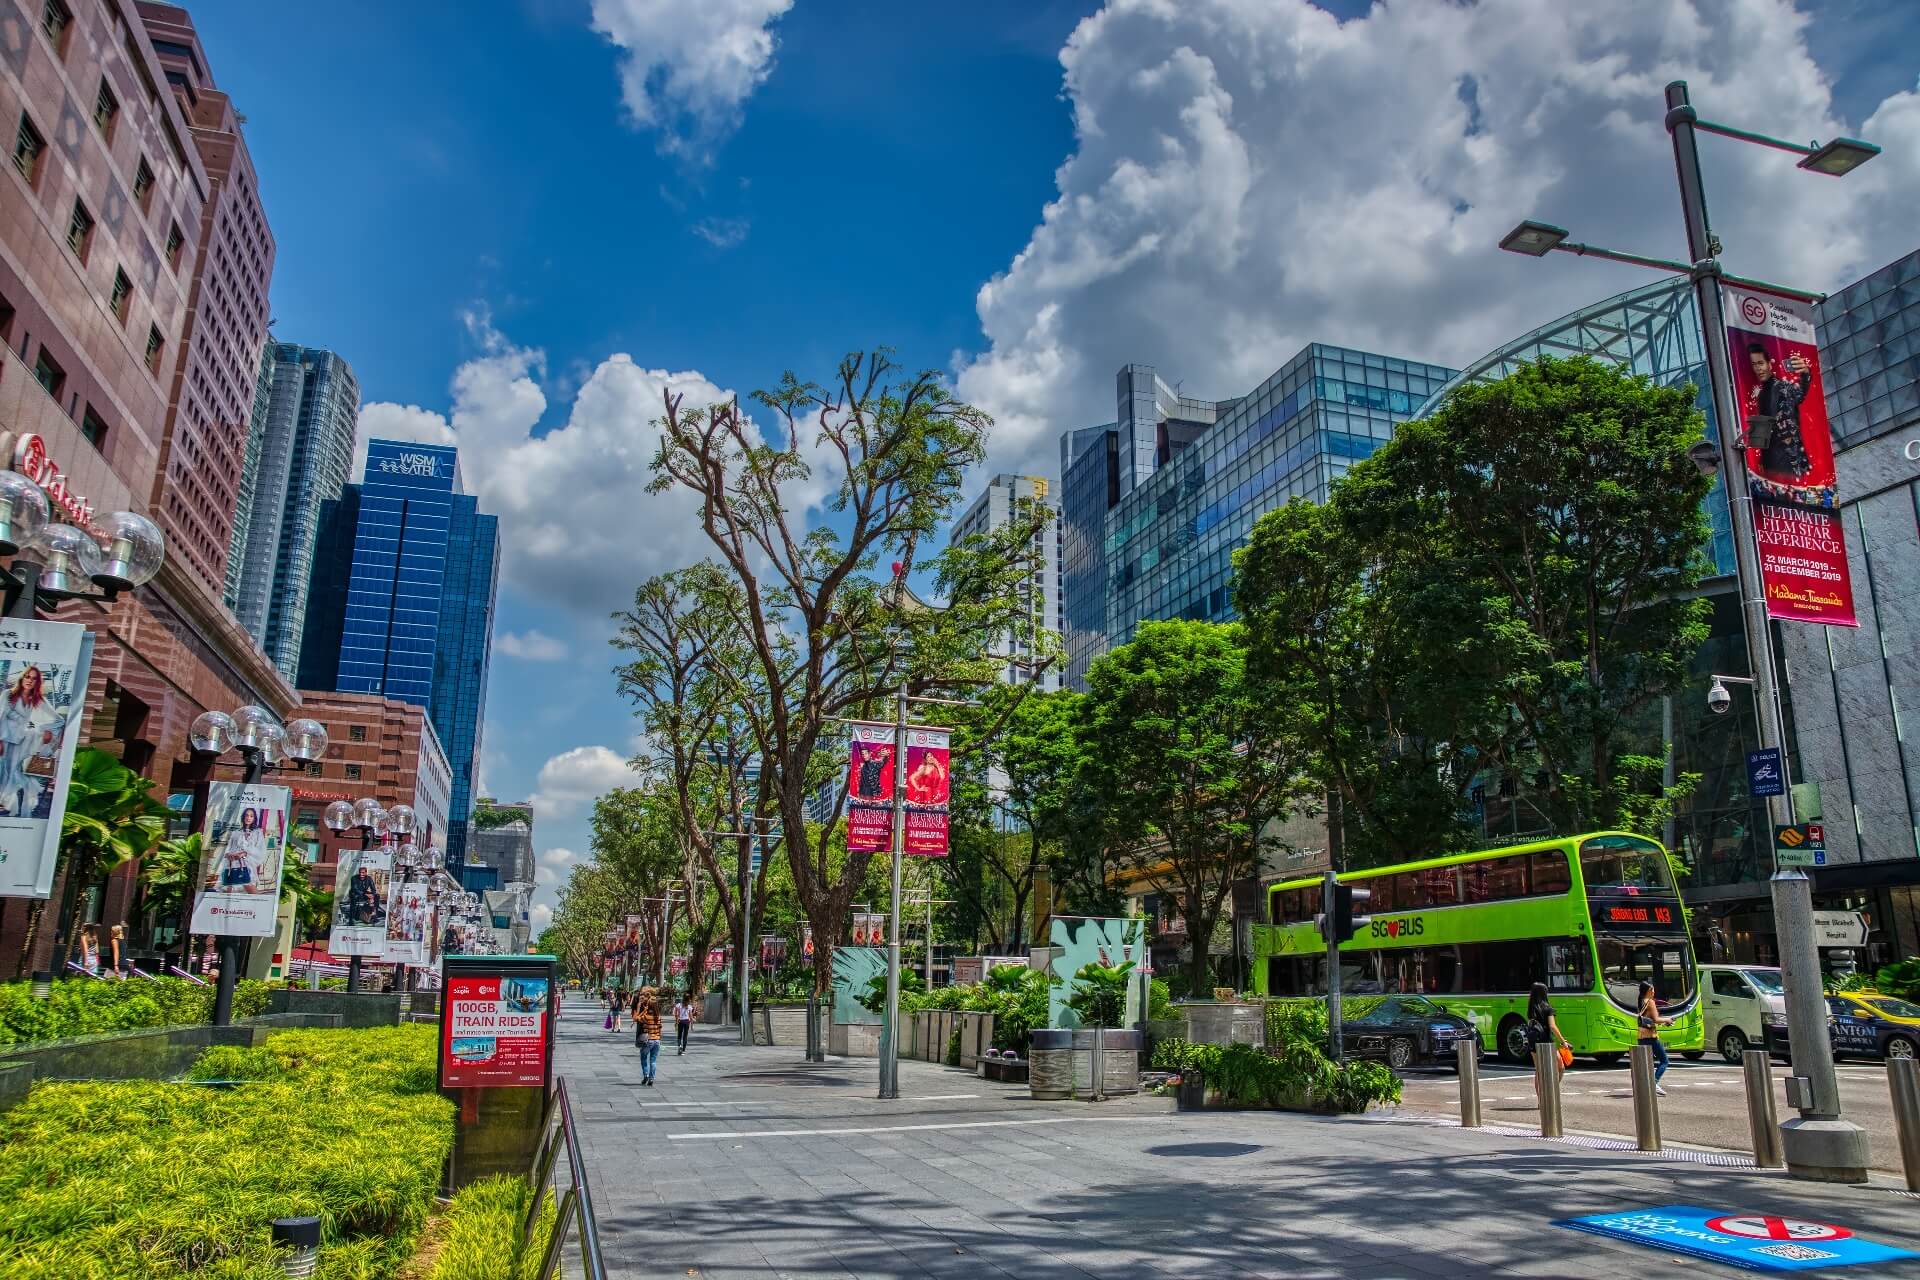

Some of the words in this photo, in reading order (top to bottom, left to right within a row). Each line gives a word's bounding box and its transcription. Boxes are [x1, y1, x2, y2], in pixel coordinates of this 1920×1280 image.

[1746, 304, 1763, 318] SG
[400, 453, 444, 467] WISMA
[407, 463, 443, 477] ATRIA
[1761, 504, 1831, 527] ULTIMATE
[1763, 517, 1796, 534] FILM
[1799, 522, 1832, 540] STAR
[1758, 529, 1842, 554] EXPERIENCE
[1778, 556, 1810, 568] MARCH
[1811, 561, 1829, 571] 2019
[1775, 564, 1820, 579] DECEMBER
[1821, 571, 1842, 581] 2019
[1769, 584, 1808, 602] Madame
[1804, 589, 1843, 607] Tussauds
[229, 795, 267, 803] COACH
[1654, 906, 1671, 923] 143
[456, 1002, 499, 1015] 100GB,
[456, 1016, 495, 1027] TRAIN
[499, 1016, 535, 1027] RIDES
[1834, 1024, 1878, 1037] ANTOM
